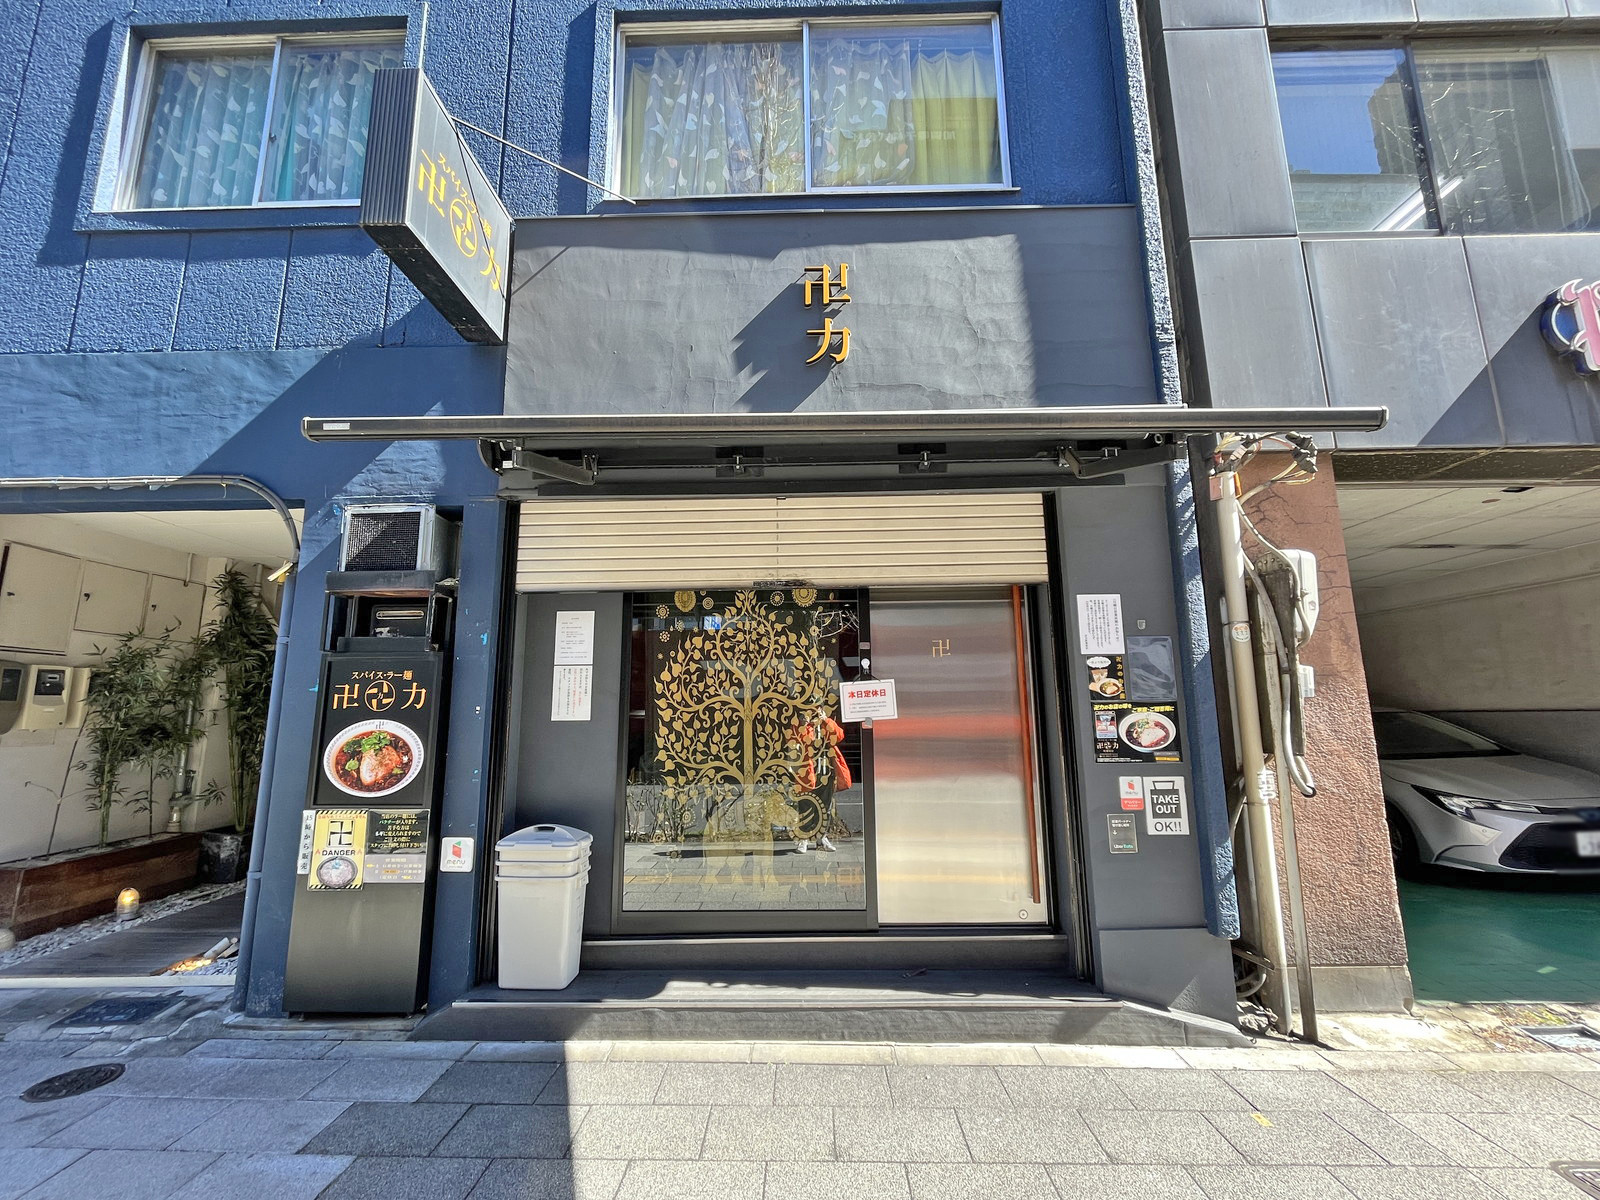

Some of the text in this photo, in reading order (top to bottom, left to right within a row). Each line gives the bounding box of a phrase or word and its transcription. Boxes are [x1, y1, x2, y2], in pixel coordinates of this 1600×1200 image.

[804, 263, 852, 365] 卍力
[351, 670, 413, 680] スパイス・ラー麺
[848, 688, 887, 699] 本日定休日
[1152, 795, 1180, 804] TAKE
[1156, 804, 1177, 813] OUT
[1154, 821, 1182, 832] OK!!
[301, 814, 313, 870] 15時から販売
